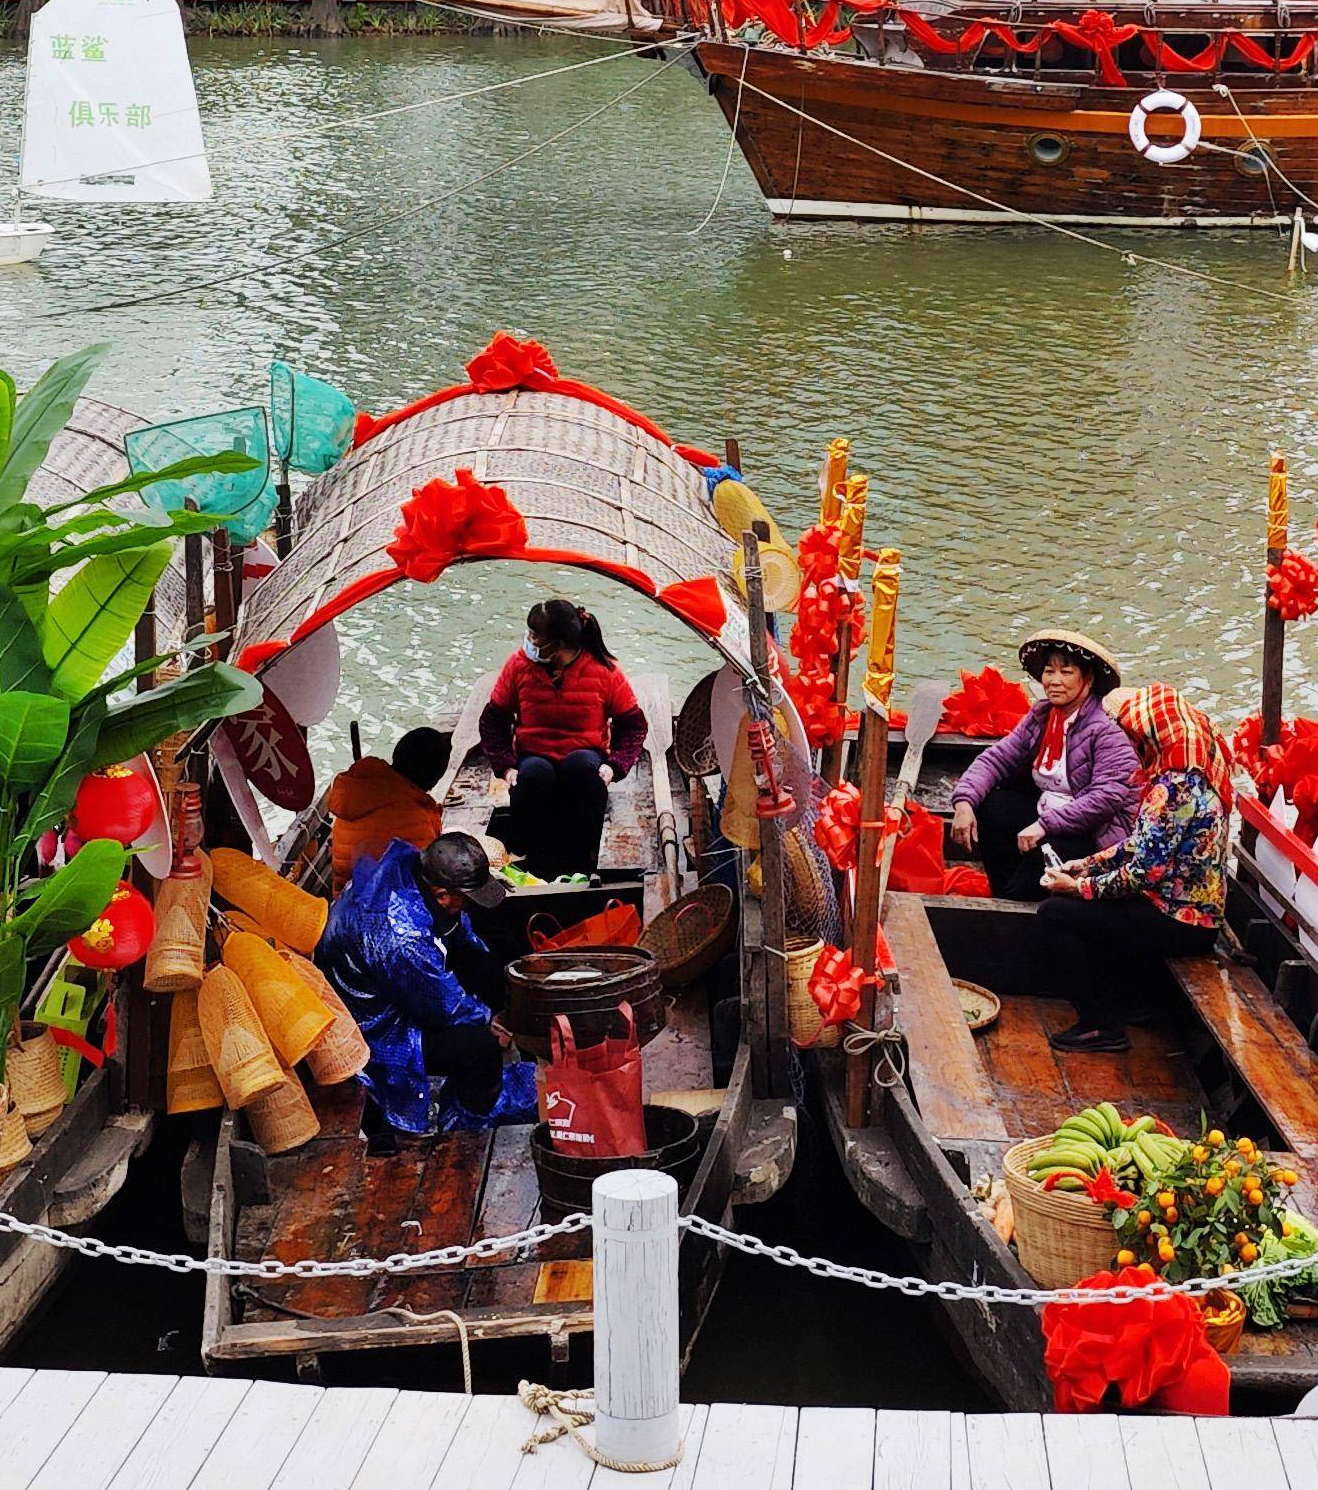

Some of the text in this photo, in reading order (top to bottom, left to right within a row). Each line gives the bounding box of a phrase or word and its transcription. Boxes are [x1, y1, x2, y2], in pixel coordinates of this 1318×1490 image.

[50, 34, 110, 63] 蓝鲨
[69, 100, 152, 130] 俱乐部
